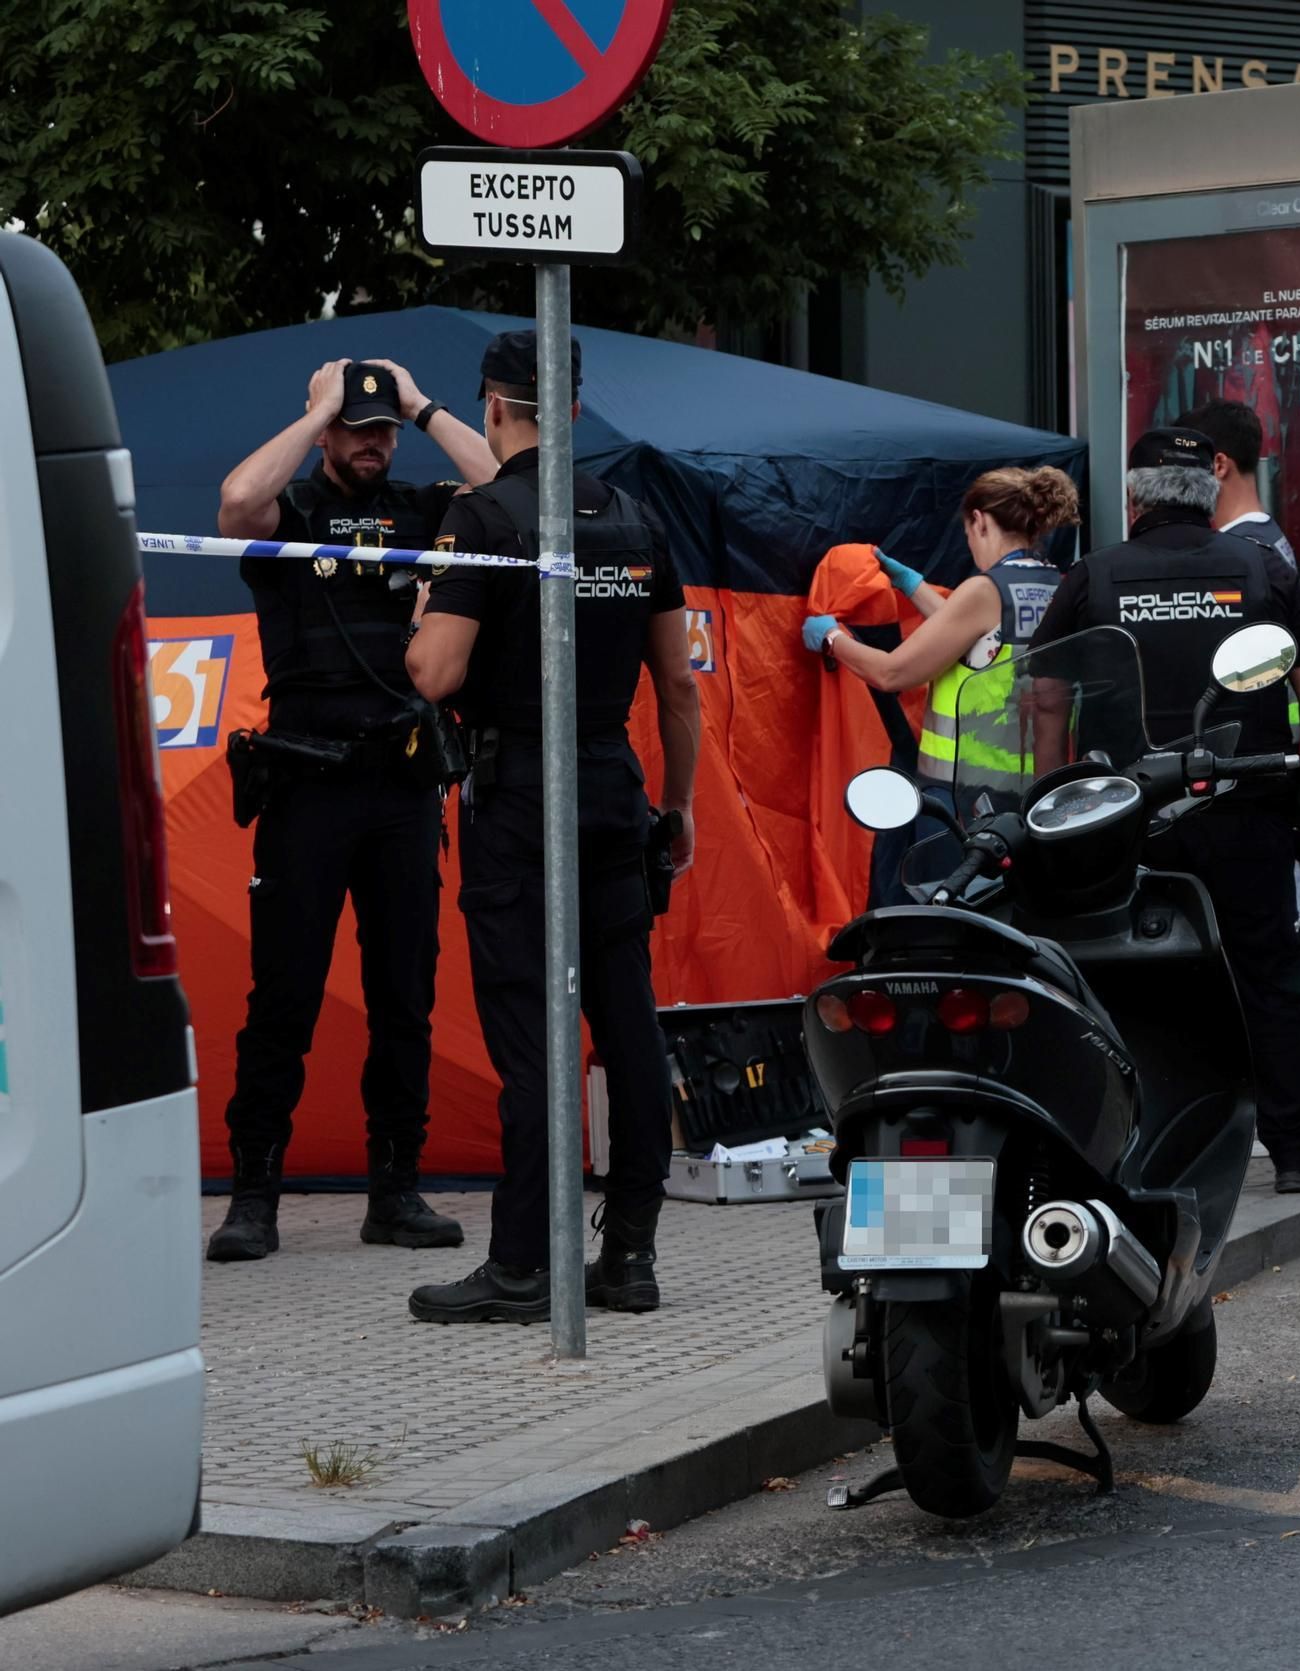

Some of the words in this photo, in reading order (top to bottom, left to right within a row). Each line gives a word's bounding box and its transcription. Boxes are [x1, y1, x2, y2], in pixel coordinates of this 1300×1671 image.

[469, 173, 575, 201] EXCEPTO
[473, 212, 572, 240] TUSSAM
[1263, 290, 1277, 303] EL
[1144, 316, 1184, 331] SÉRUM
[1187, 309, 1274, 327] REVITALIZANTE
[1175, 437, 1198, 447] CNP
[329, 518, 381, 527] POLICIA
[140, 537, 175, 550] LINEA
[575, 582, 651, 597] CIONAL
[1119, 591, 1218, 609] POLICIA
[1120, 605, 1243, 623] NACIONAL
[885, 981, 939, 995] YAMAHA
